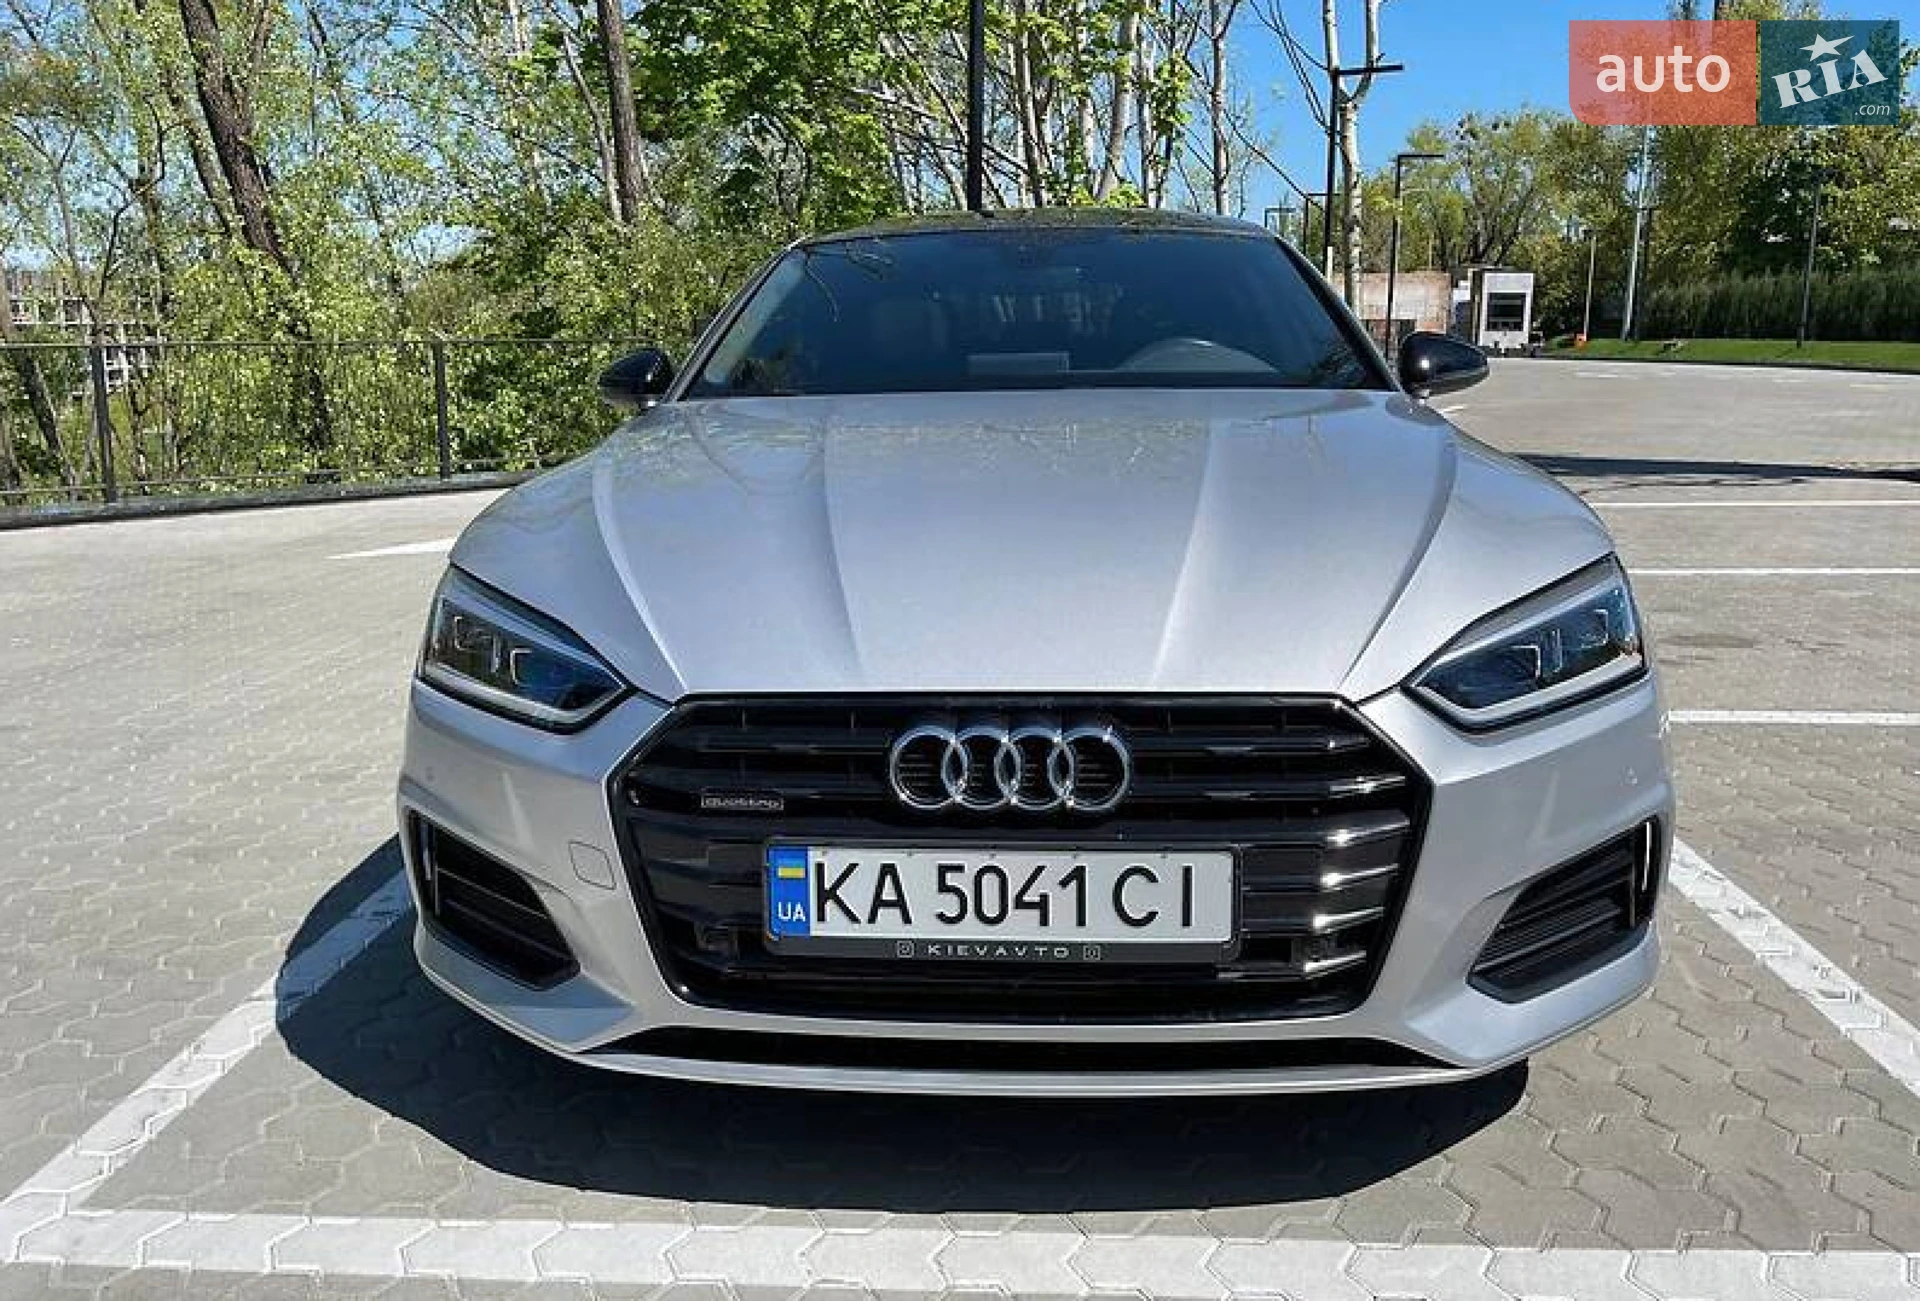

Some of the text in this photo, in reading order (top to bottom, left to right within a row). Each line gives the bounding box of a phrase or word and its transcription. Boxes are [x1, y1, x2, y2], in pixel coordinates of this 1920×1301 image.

[815, 863, 1194, 928] KA 5041 CI
[778, 902, 806, 923] UA
[927, 945, 1070, 957] KIEVAVTO
